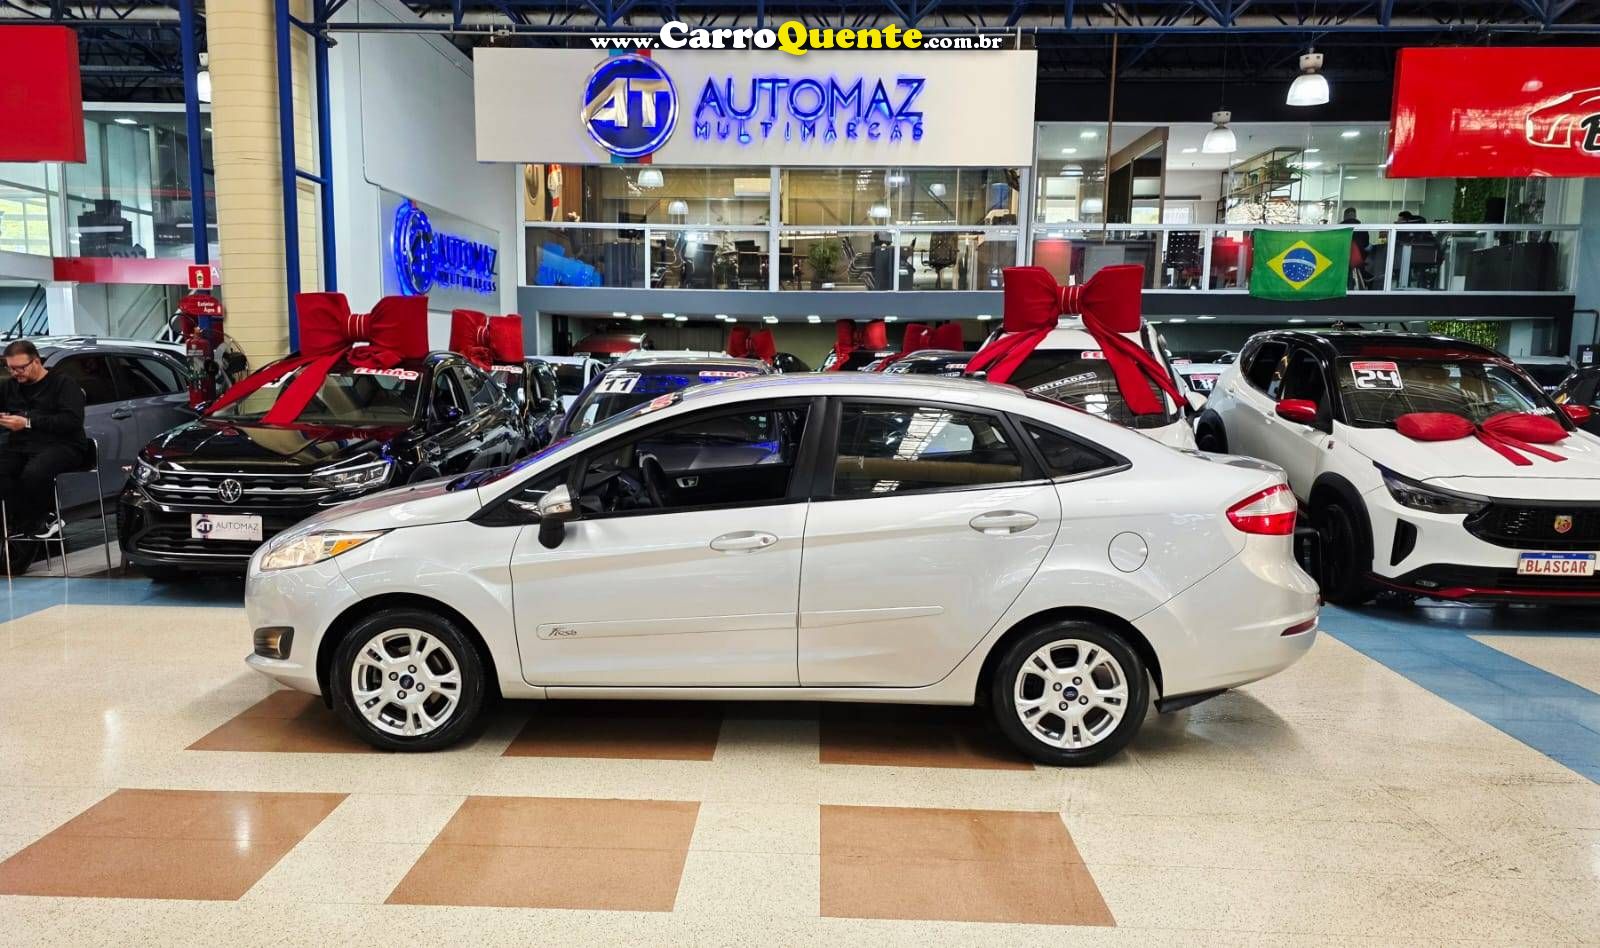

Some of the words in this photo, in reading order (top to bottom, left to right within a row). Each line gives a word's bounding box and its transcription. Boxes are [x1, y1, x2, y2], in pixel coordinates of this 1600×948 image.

[695, 77, 926, 122] AUTOMAZ
[695, 121, 925, 143] MULTIMARCAS
[605, 379, 632, 391] 11
[1357, 370, 1401, 388] 24
[215, 521, 259, 531] AUTOMAZ
[1526, 560, 1587, 573] BLASCAR
